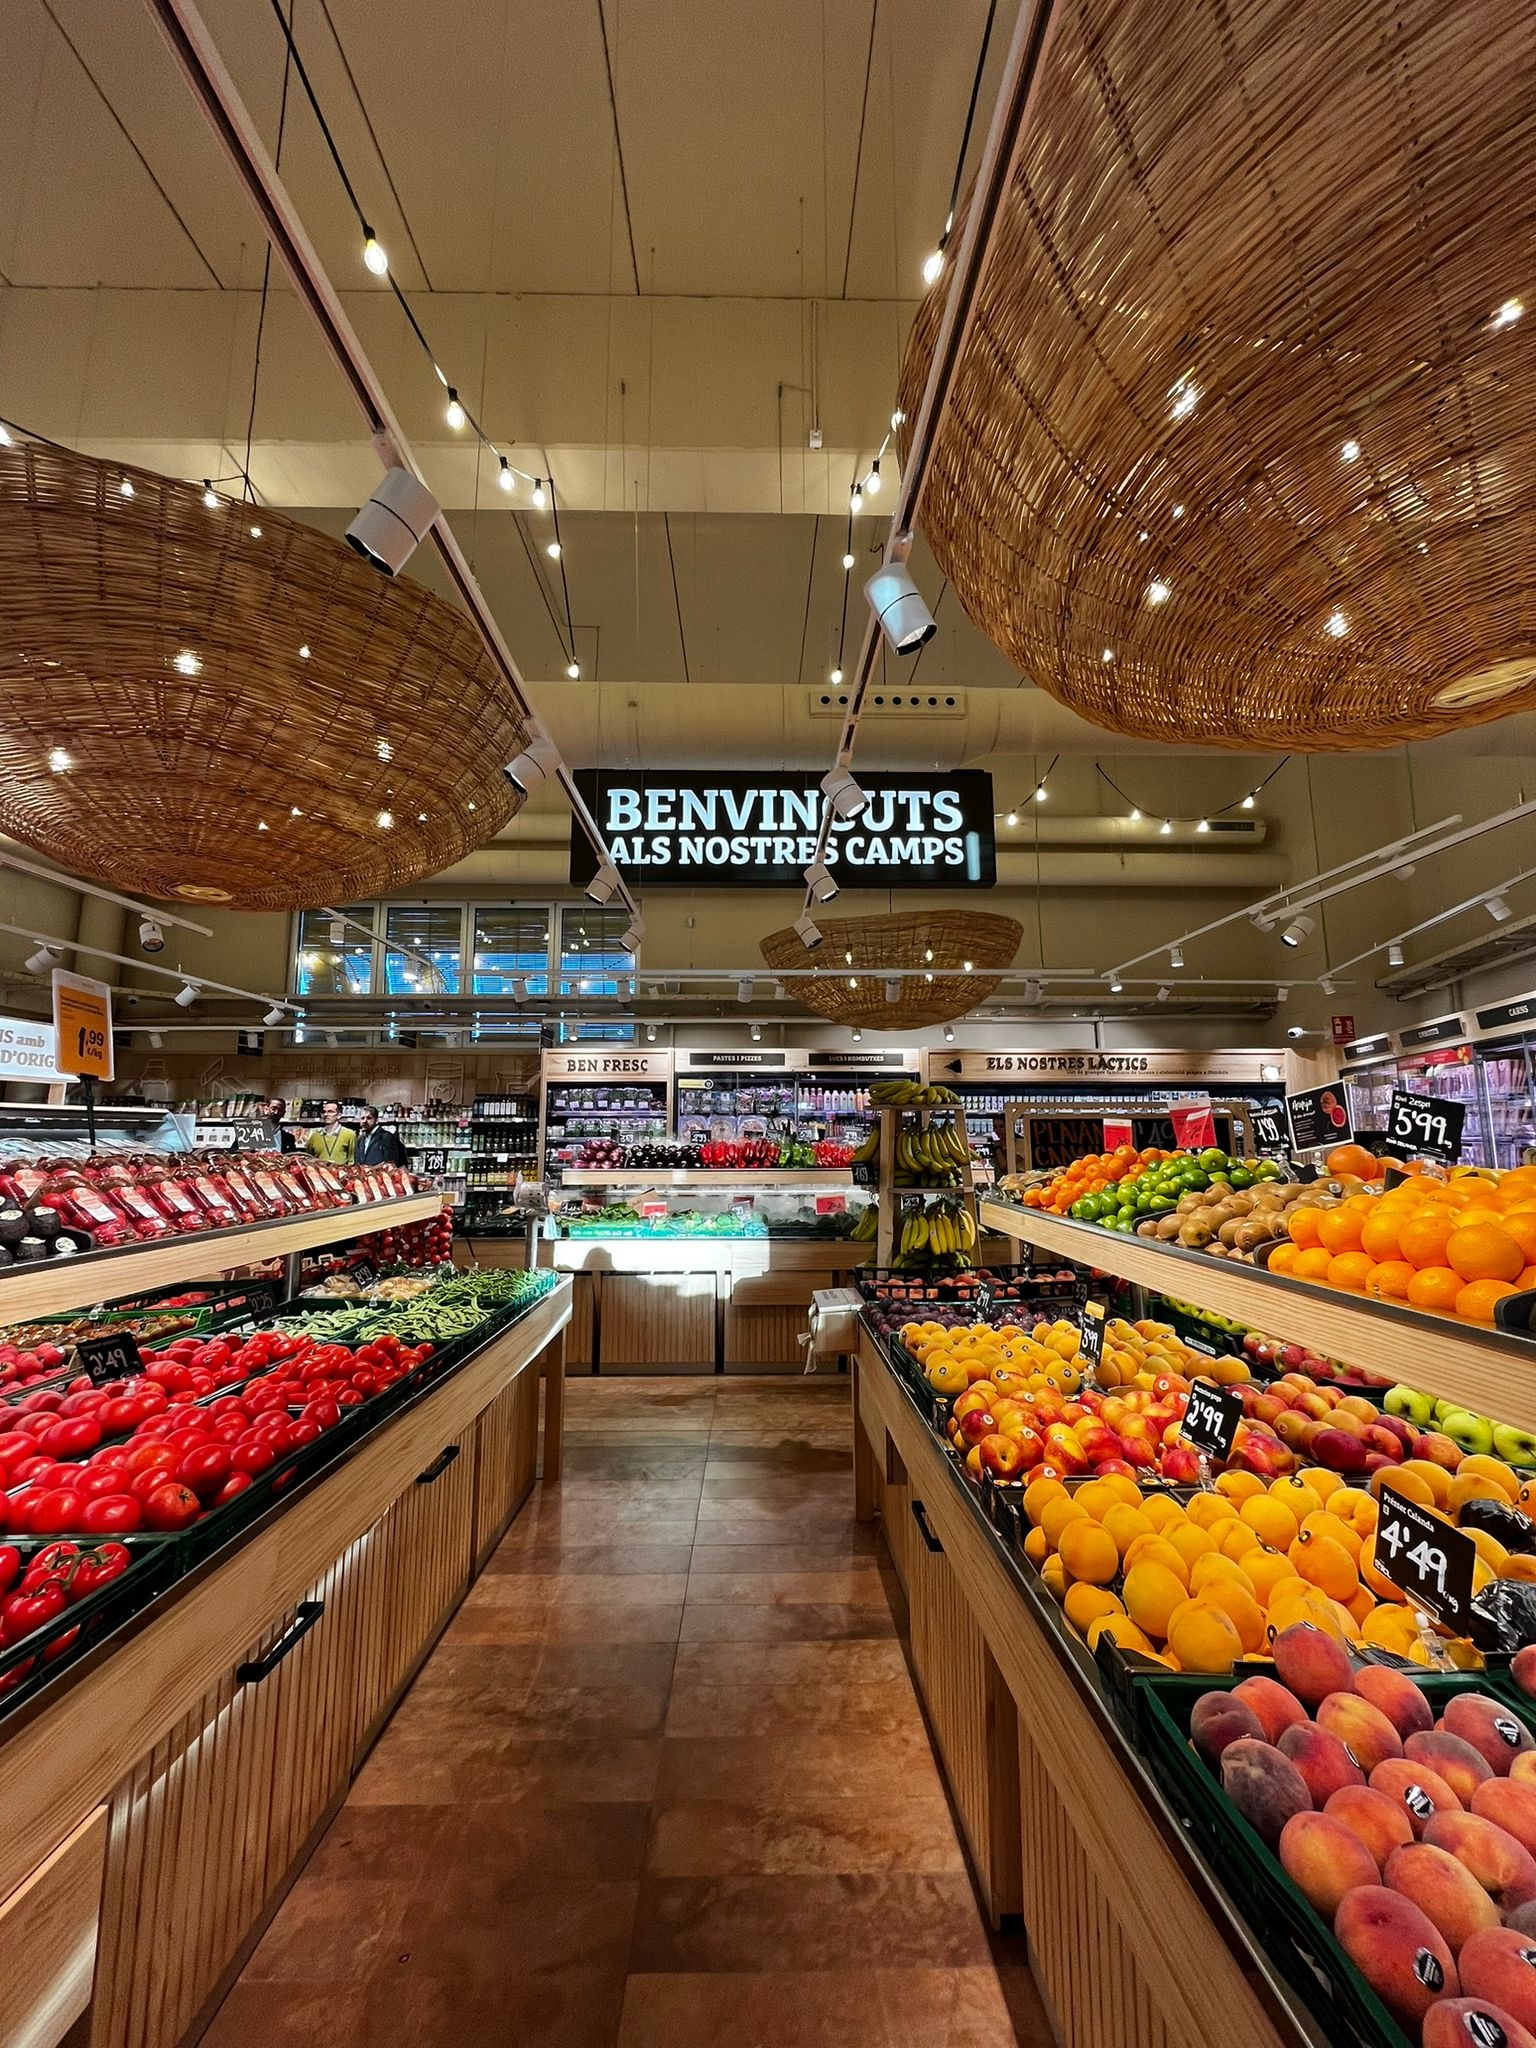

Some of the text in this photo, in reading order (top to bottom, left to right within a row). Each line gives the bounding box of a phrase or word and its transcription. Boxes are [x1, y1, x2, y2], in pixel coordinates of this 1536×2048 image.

[608, 836, 965, 866] ALS NOSTRES CAMPS
[16, 1035, 46, 1048] amb
[567, 1059, 648, 1072] BEN FRESC
[986, 1057, 1013, 1071] ELS
[1017, 1057, 1085, 1071] NOSTRES
[237, 1127, 265, 1143] 2'49
[1394, 1107, 1447, 1145] 5'99
[89, 1348, 129, 1376] 2'49
[1186, 1399, 1225, 1437] 2'99
[1383, 1491, 1435, 1533] Préssec Calanda
[1380, 1520, 1448, 1594] 4'49
